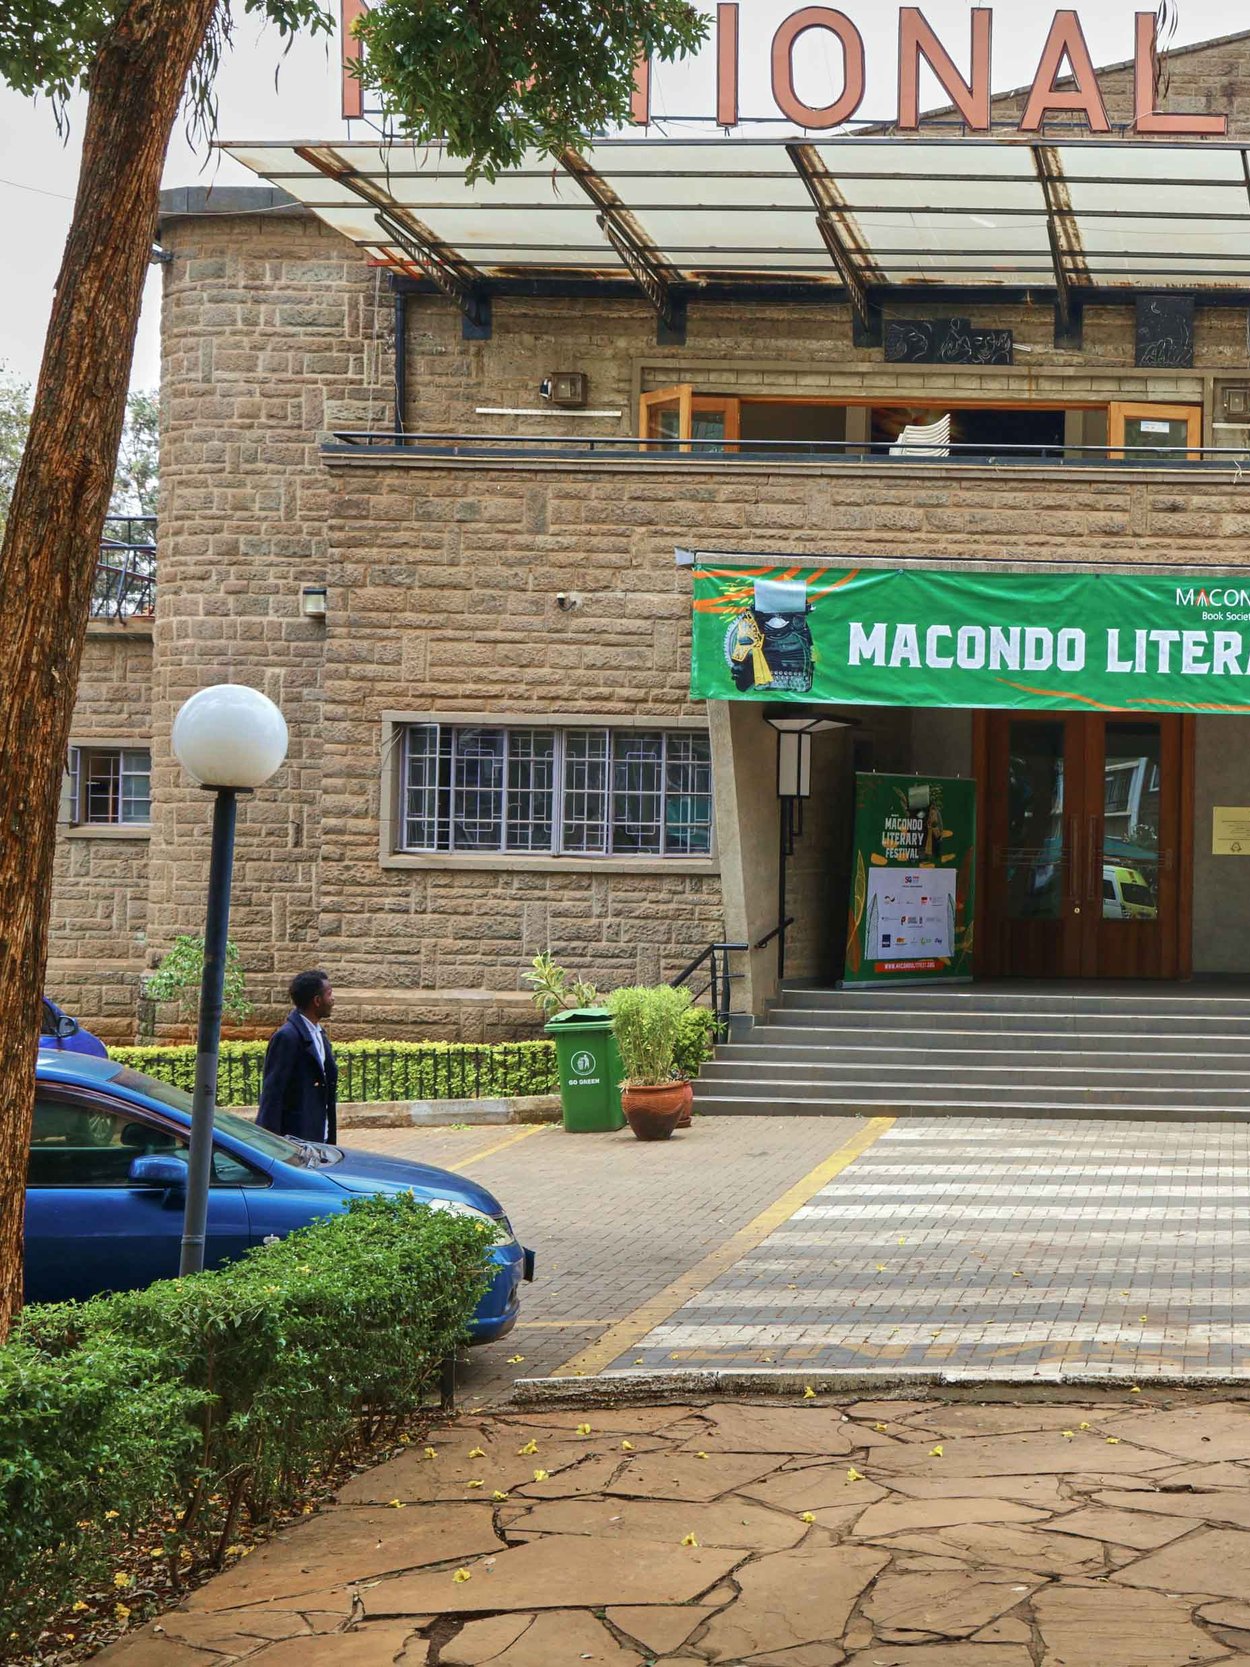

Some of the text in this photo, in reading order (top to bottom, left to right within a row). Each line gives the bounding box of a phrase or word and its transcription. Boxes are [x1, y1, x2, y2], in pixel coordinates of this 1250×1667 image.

[341, 0, 1228, 135] IONAL
[1202, 611, 1223, 621] Book
[848, 622, 1086, 672] MACONDO
[885, 818, 923, 831] MACONDO
[881, 831, 924, 845] LITERARY
[885, 847, 919, 859] FESTIVAL
